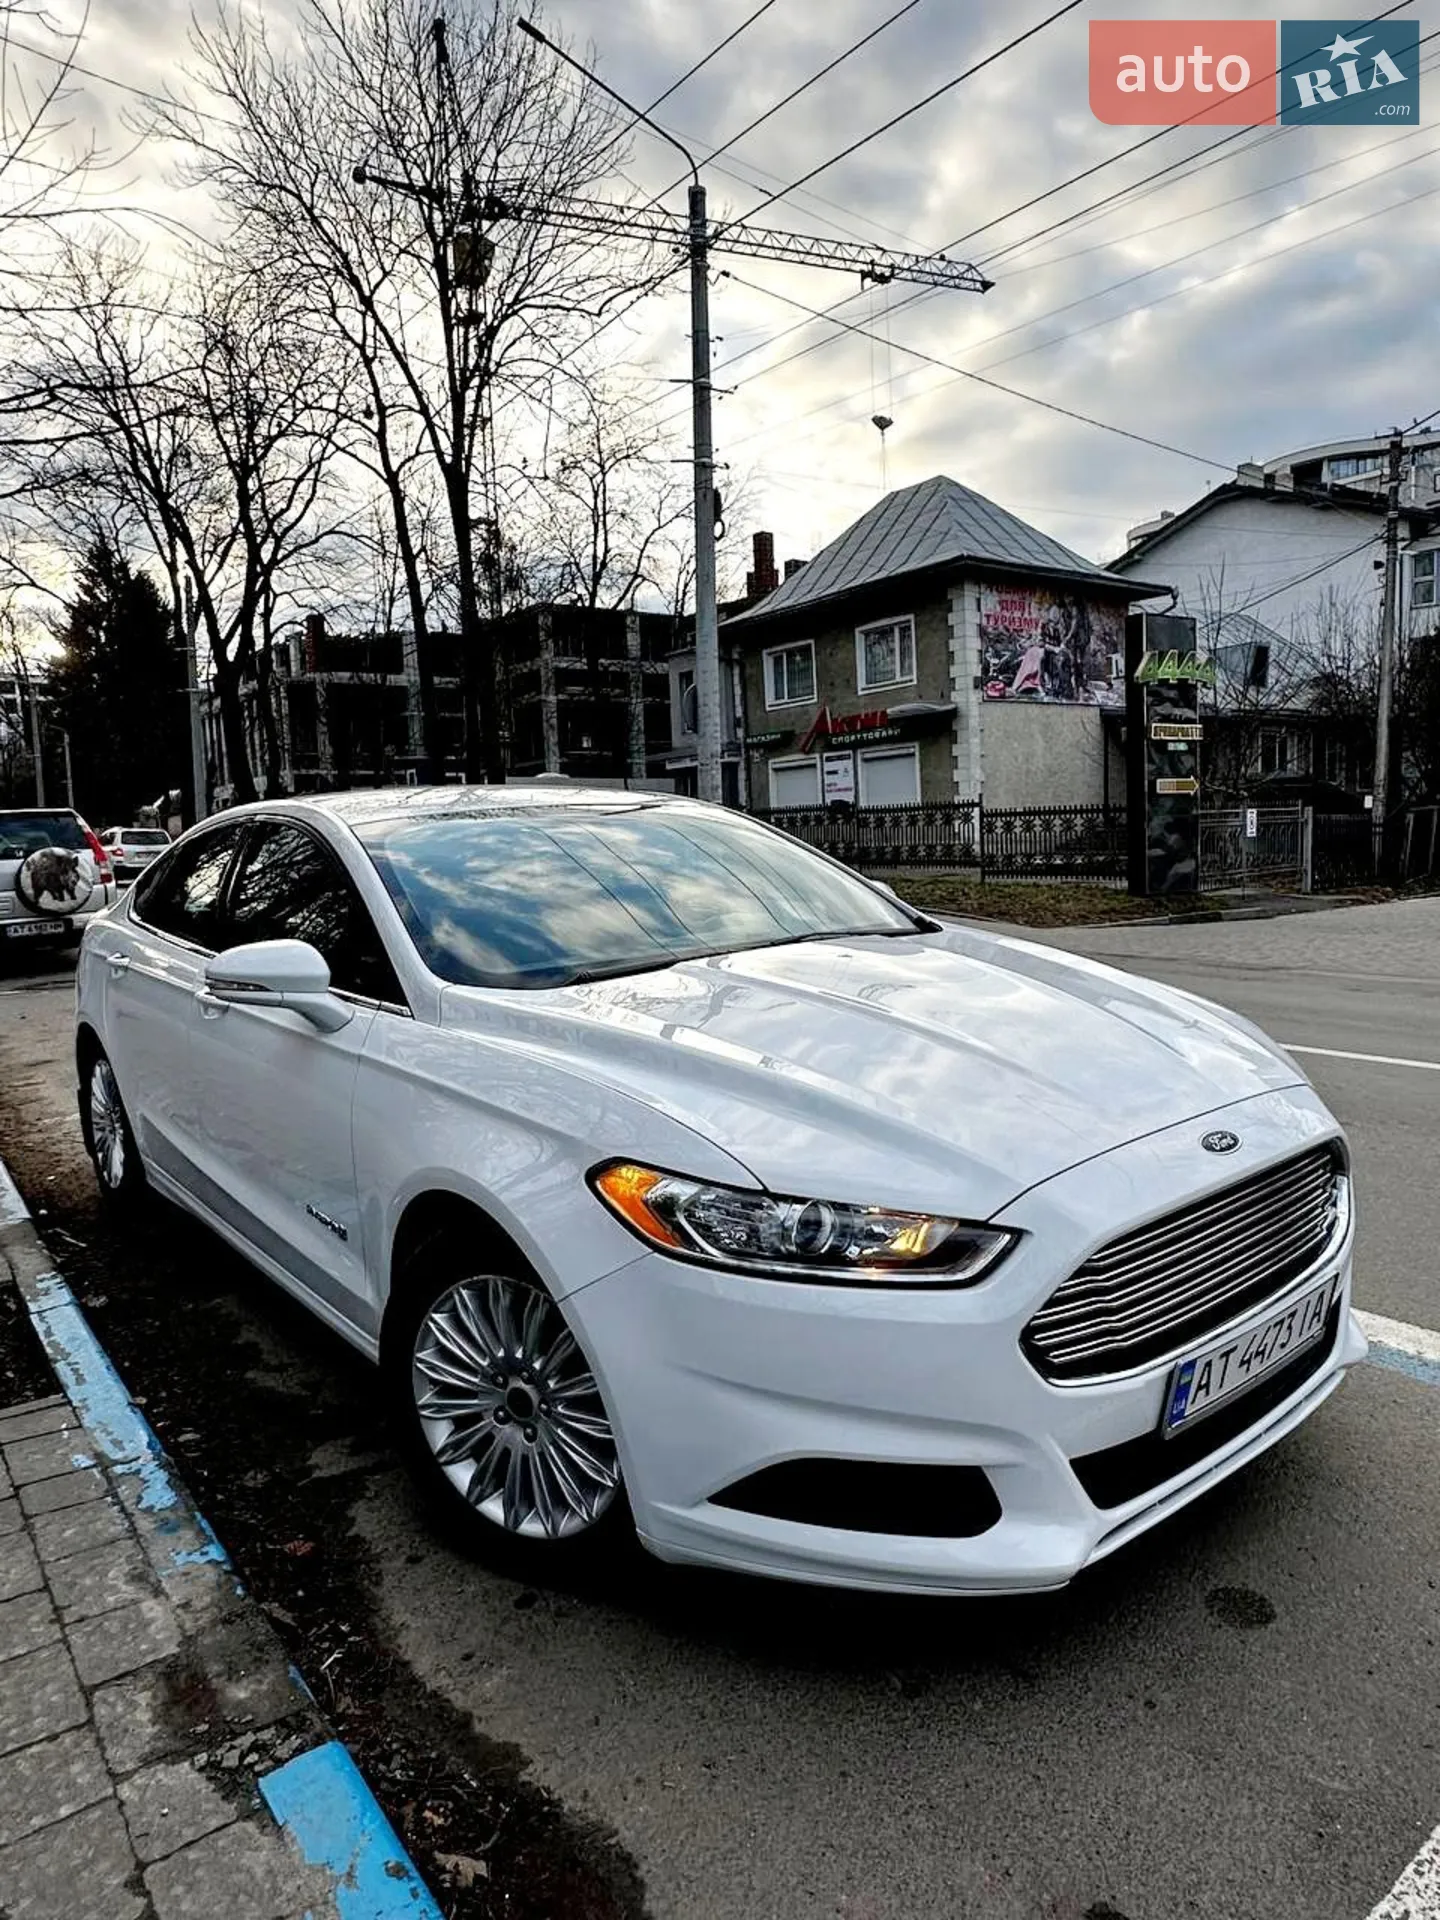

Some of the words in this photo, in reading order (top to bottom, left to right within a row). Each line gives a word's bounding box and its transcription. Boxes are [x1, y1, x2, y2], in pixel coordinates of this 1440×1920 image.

[984, 613, 1040, 630] ТУРИЗМУ
[1190, 1344, 1239, 1405] AT
[1238, 1309, 1298, 1374] 4473
[1299, 1289, 1326, 1338] IA
